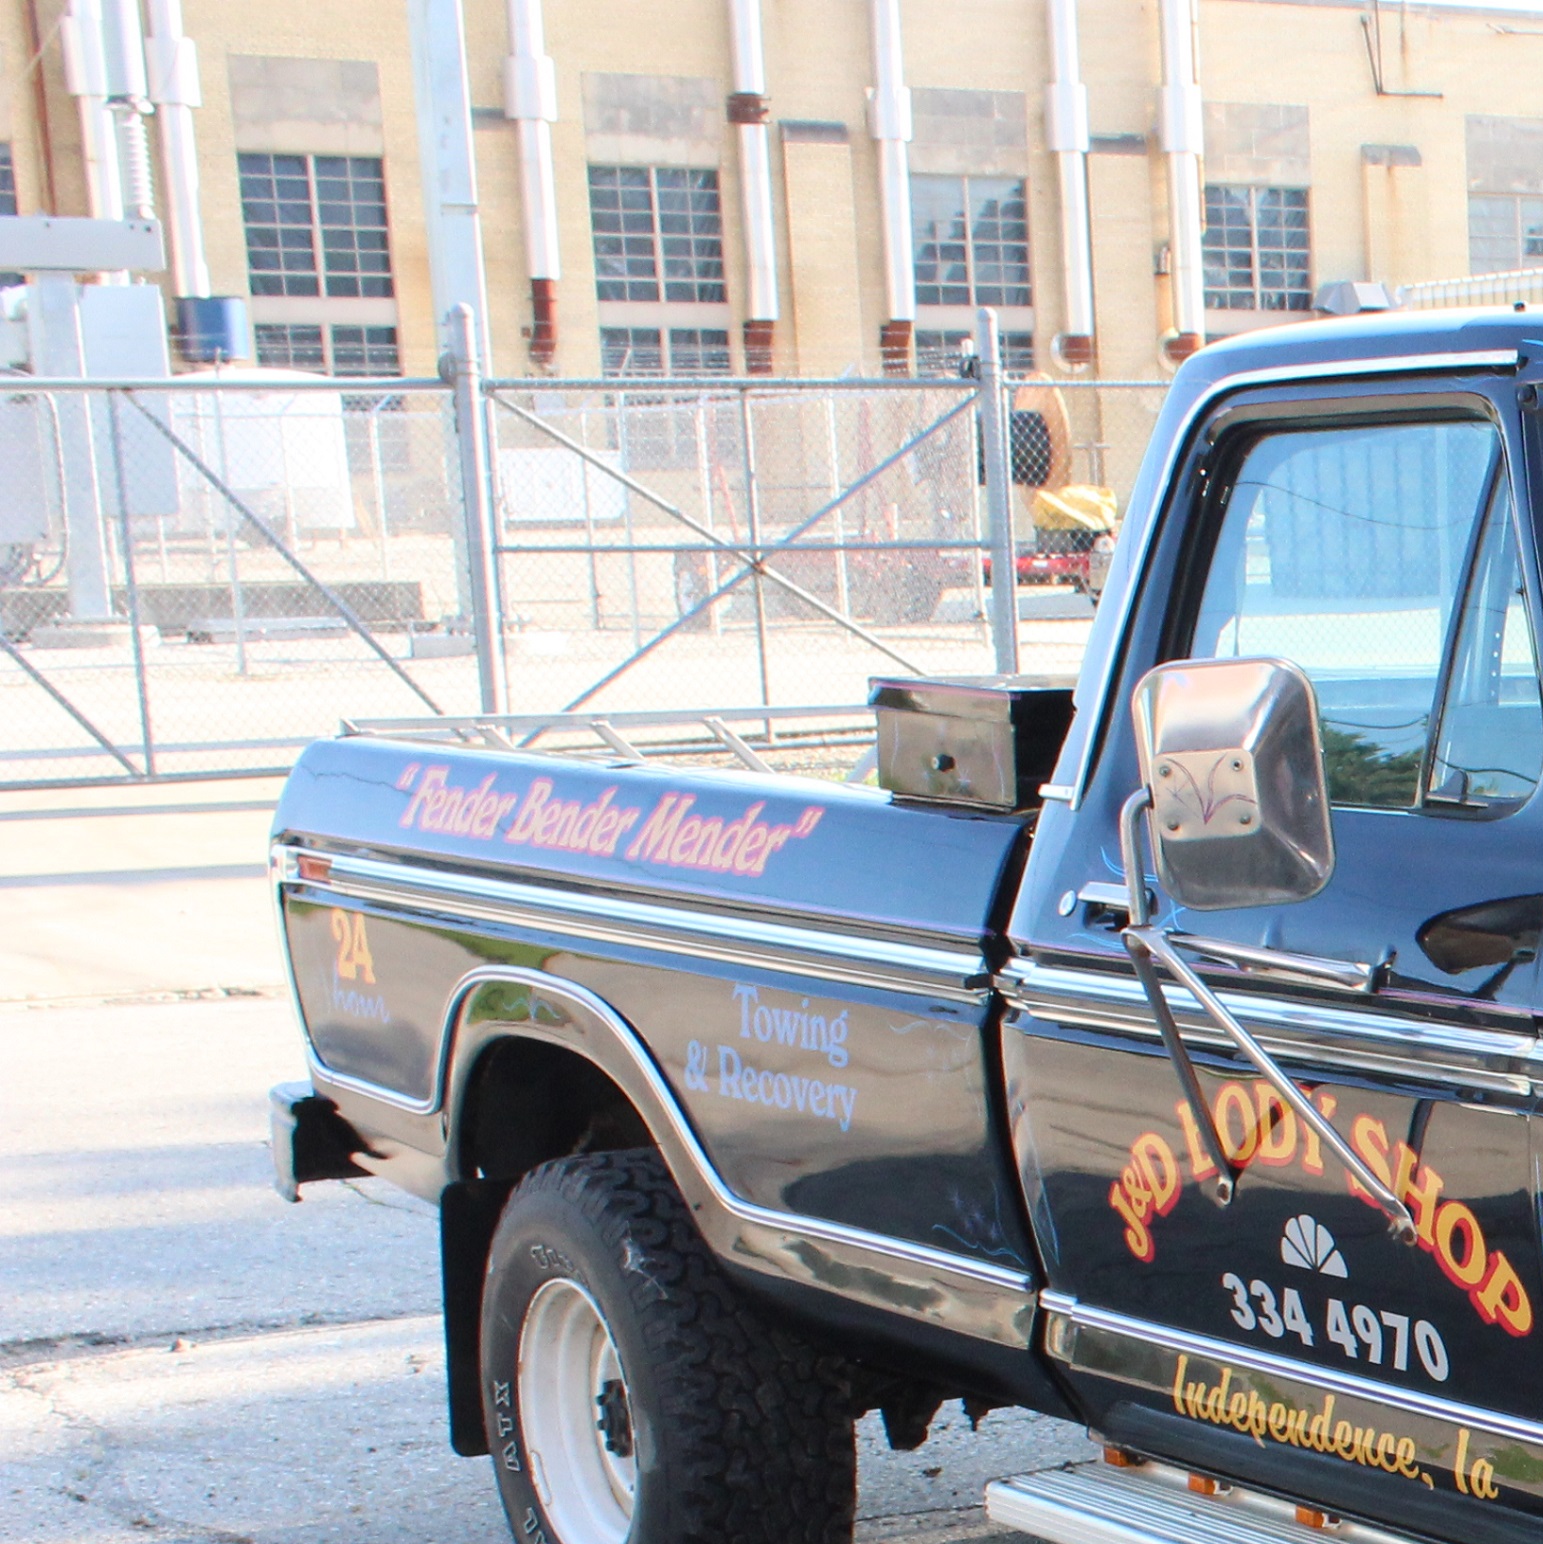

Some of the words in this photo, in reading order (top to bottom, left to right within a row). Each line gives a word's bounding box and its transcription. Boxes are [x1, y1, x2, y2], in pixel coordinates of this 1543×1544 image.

[504, 776, 641, 858] Bender
[331, 906, 376, 984] 24
[733, 984, 849, 1068] Towing
[685, 1039, 710, 1092] &
[717, 1045, 858, 1132] Recovery
[1109, 1132, 1181, 1262] J&D
[1345, 1113, 1533, 1337] SHOP
[1222, 1272, 1314, 1348] 334
[1326, 1299, 1449, 1382] 4970
[494, 1381, 522, 1472] ATX
[1172, 1354, 1435, 1490] Independence,
